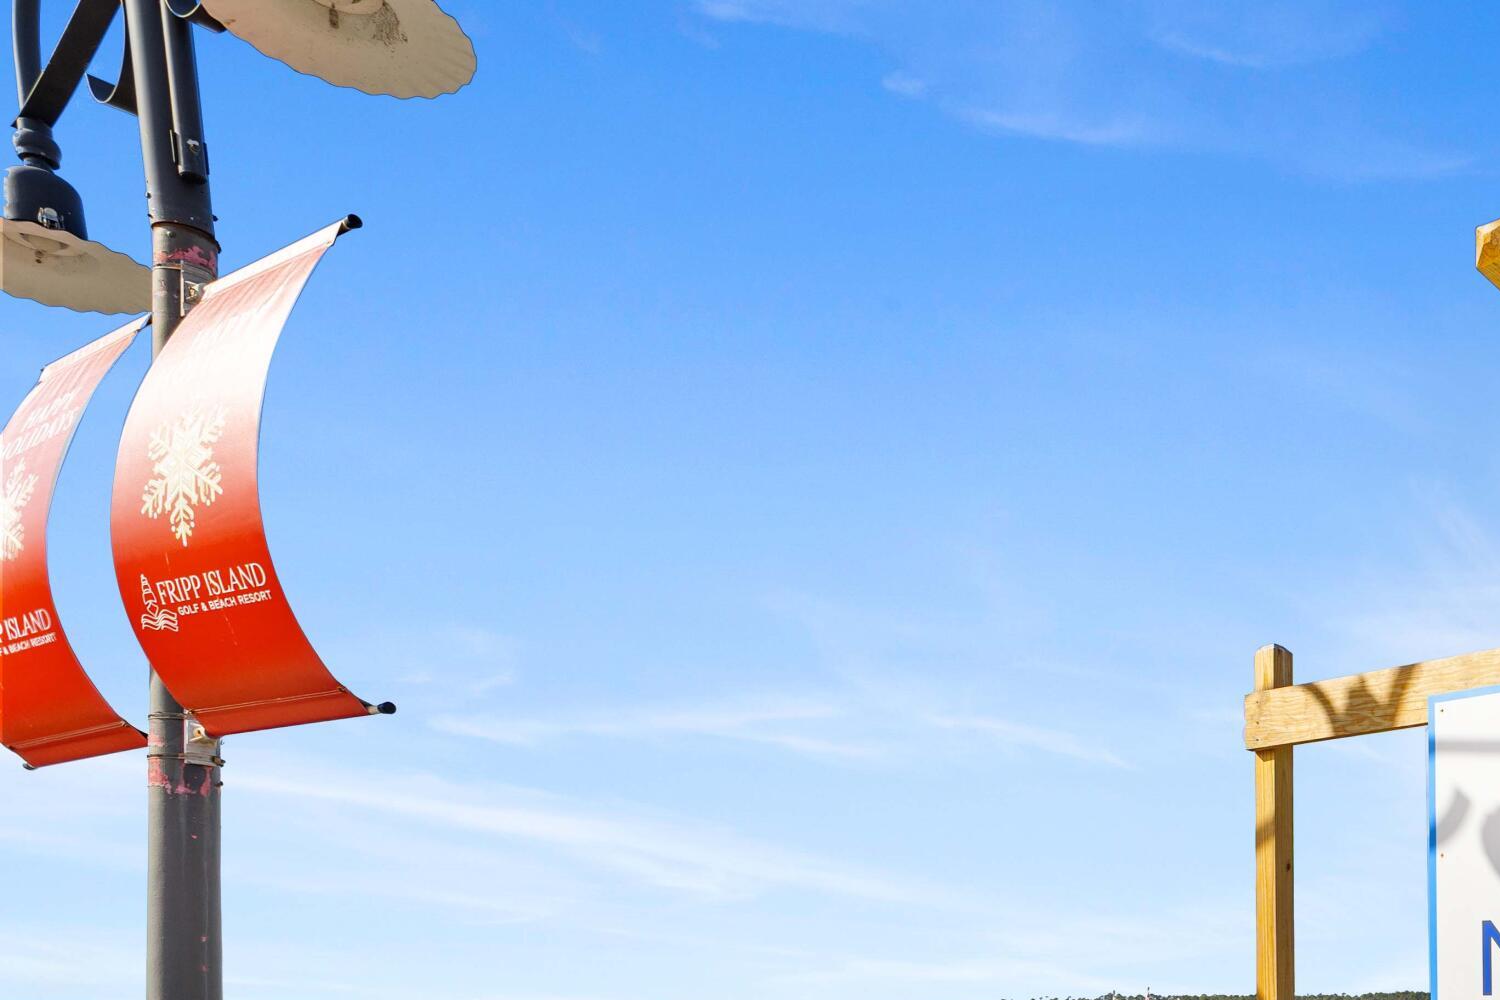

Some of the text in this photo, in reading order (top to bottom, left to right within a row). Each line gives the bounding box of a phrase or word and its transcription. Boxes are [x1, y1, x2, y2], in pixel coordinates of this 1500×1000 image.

[155, 562, 266, 605] FRIPP ISLAND
[177, 589, 272, 616] GOLF & BEACH RESORT
[4, 608, 51, 640] ISLAND
